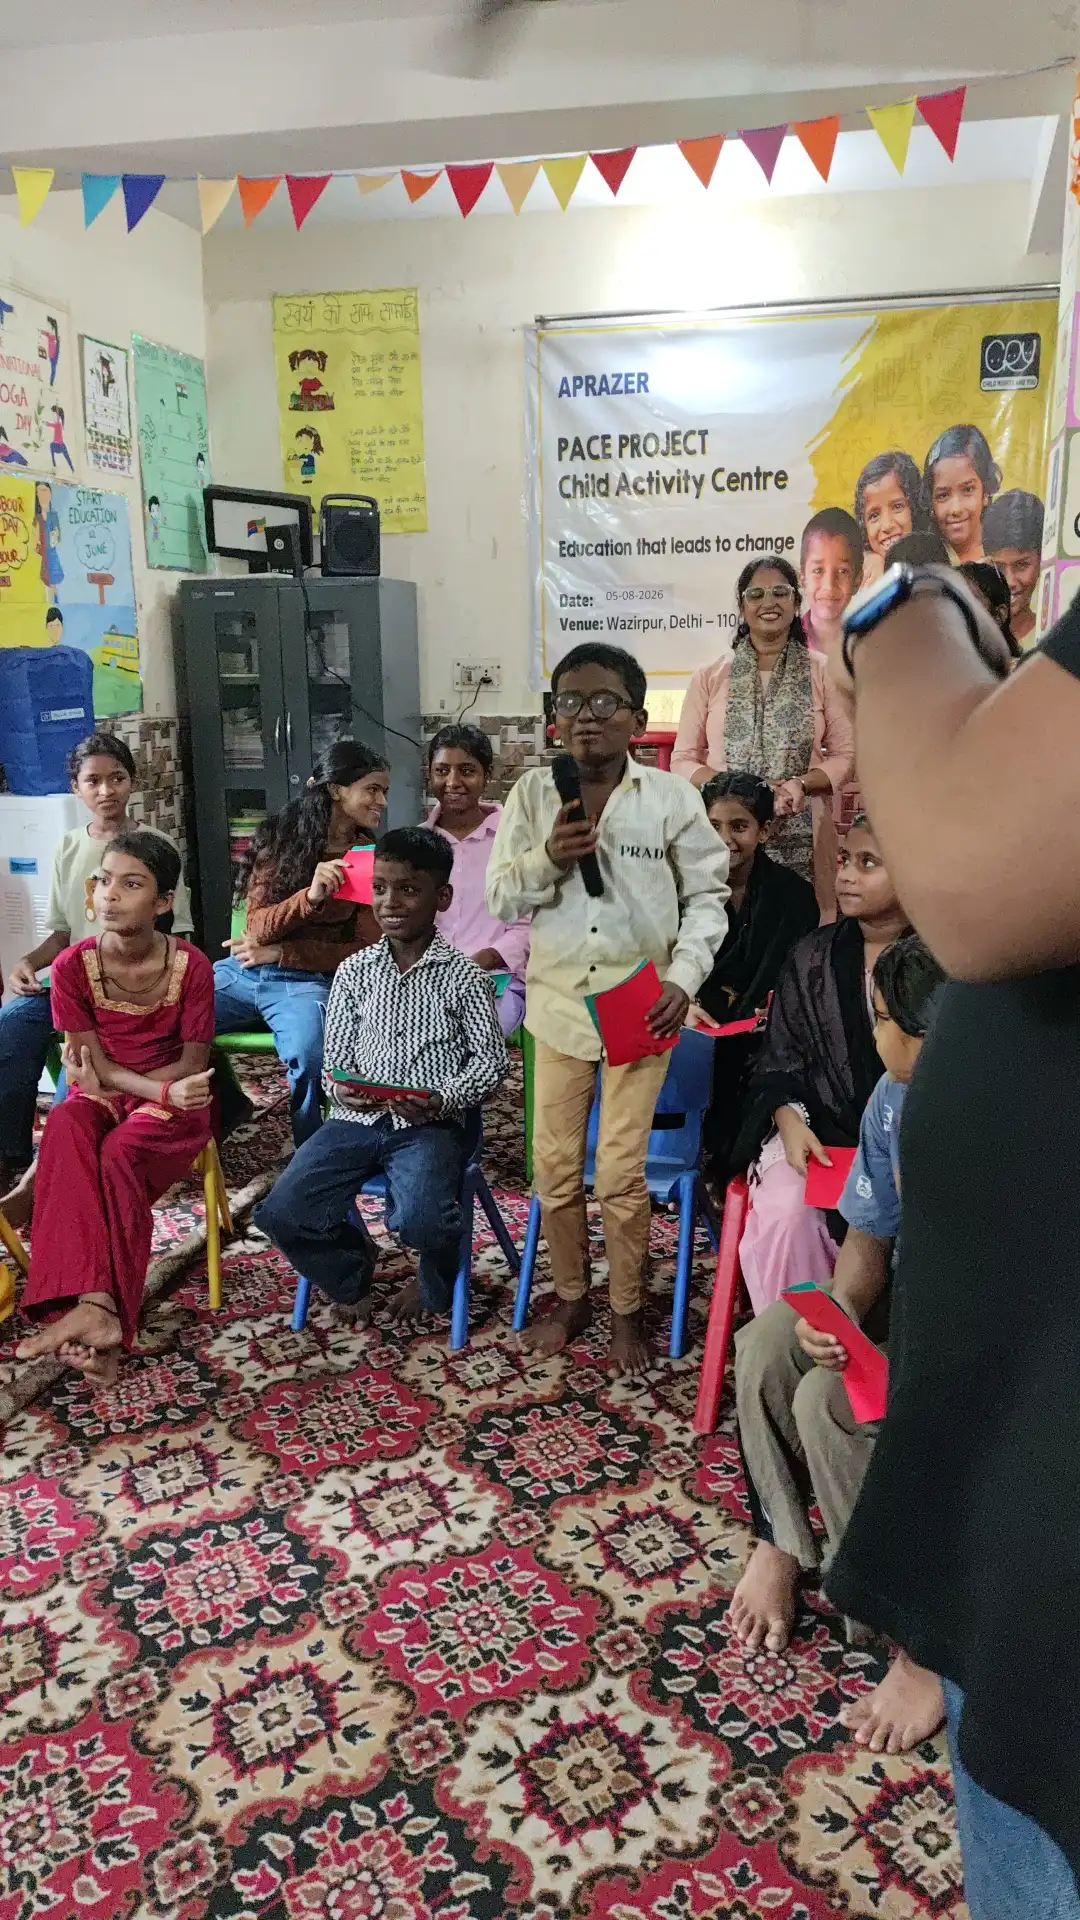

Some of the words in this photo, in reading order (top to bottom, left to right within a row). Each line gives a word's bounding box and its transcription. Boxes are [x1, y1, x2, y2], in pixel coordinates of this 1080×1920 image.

[0, 383, 28, 407] OGA
[558, 372, 650, 398] APRAZER
[15, 412, 33, 437] DAY
[557, 434, 612, 462] PACE
[618, 429, 709, 459] PROJECT
[558, 472, 609, 499] Child
[615, 469, 705, 499] Activity
[711, 466, 789, 492] Centre
[0, 496, 24, 512] BOUR
[76, 490, 104, 506] START
[68, 507, 118, 524] EDUCATION
[2, 516, 19, 536] DAY
[559, 539, 632, 557] Education
[637, 537, 667, 555] that
[671, 535, 711, 554] leads
[716, 535, 731, 552] to
[735, 533, 795, 555] change
[559, 593, 594, 608] Date:
[605, 589, 664, 601] 05-08-2026
[560, 617, 604, 631] Venue:
[606, 615, 667, 633] Wazirpur,
[669, 614, 703, 629] Delhi
[620, 845, 664, 860] PRAD
